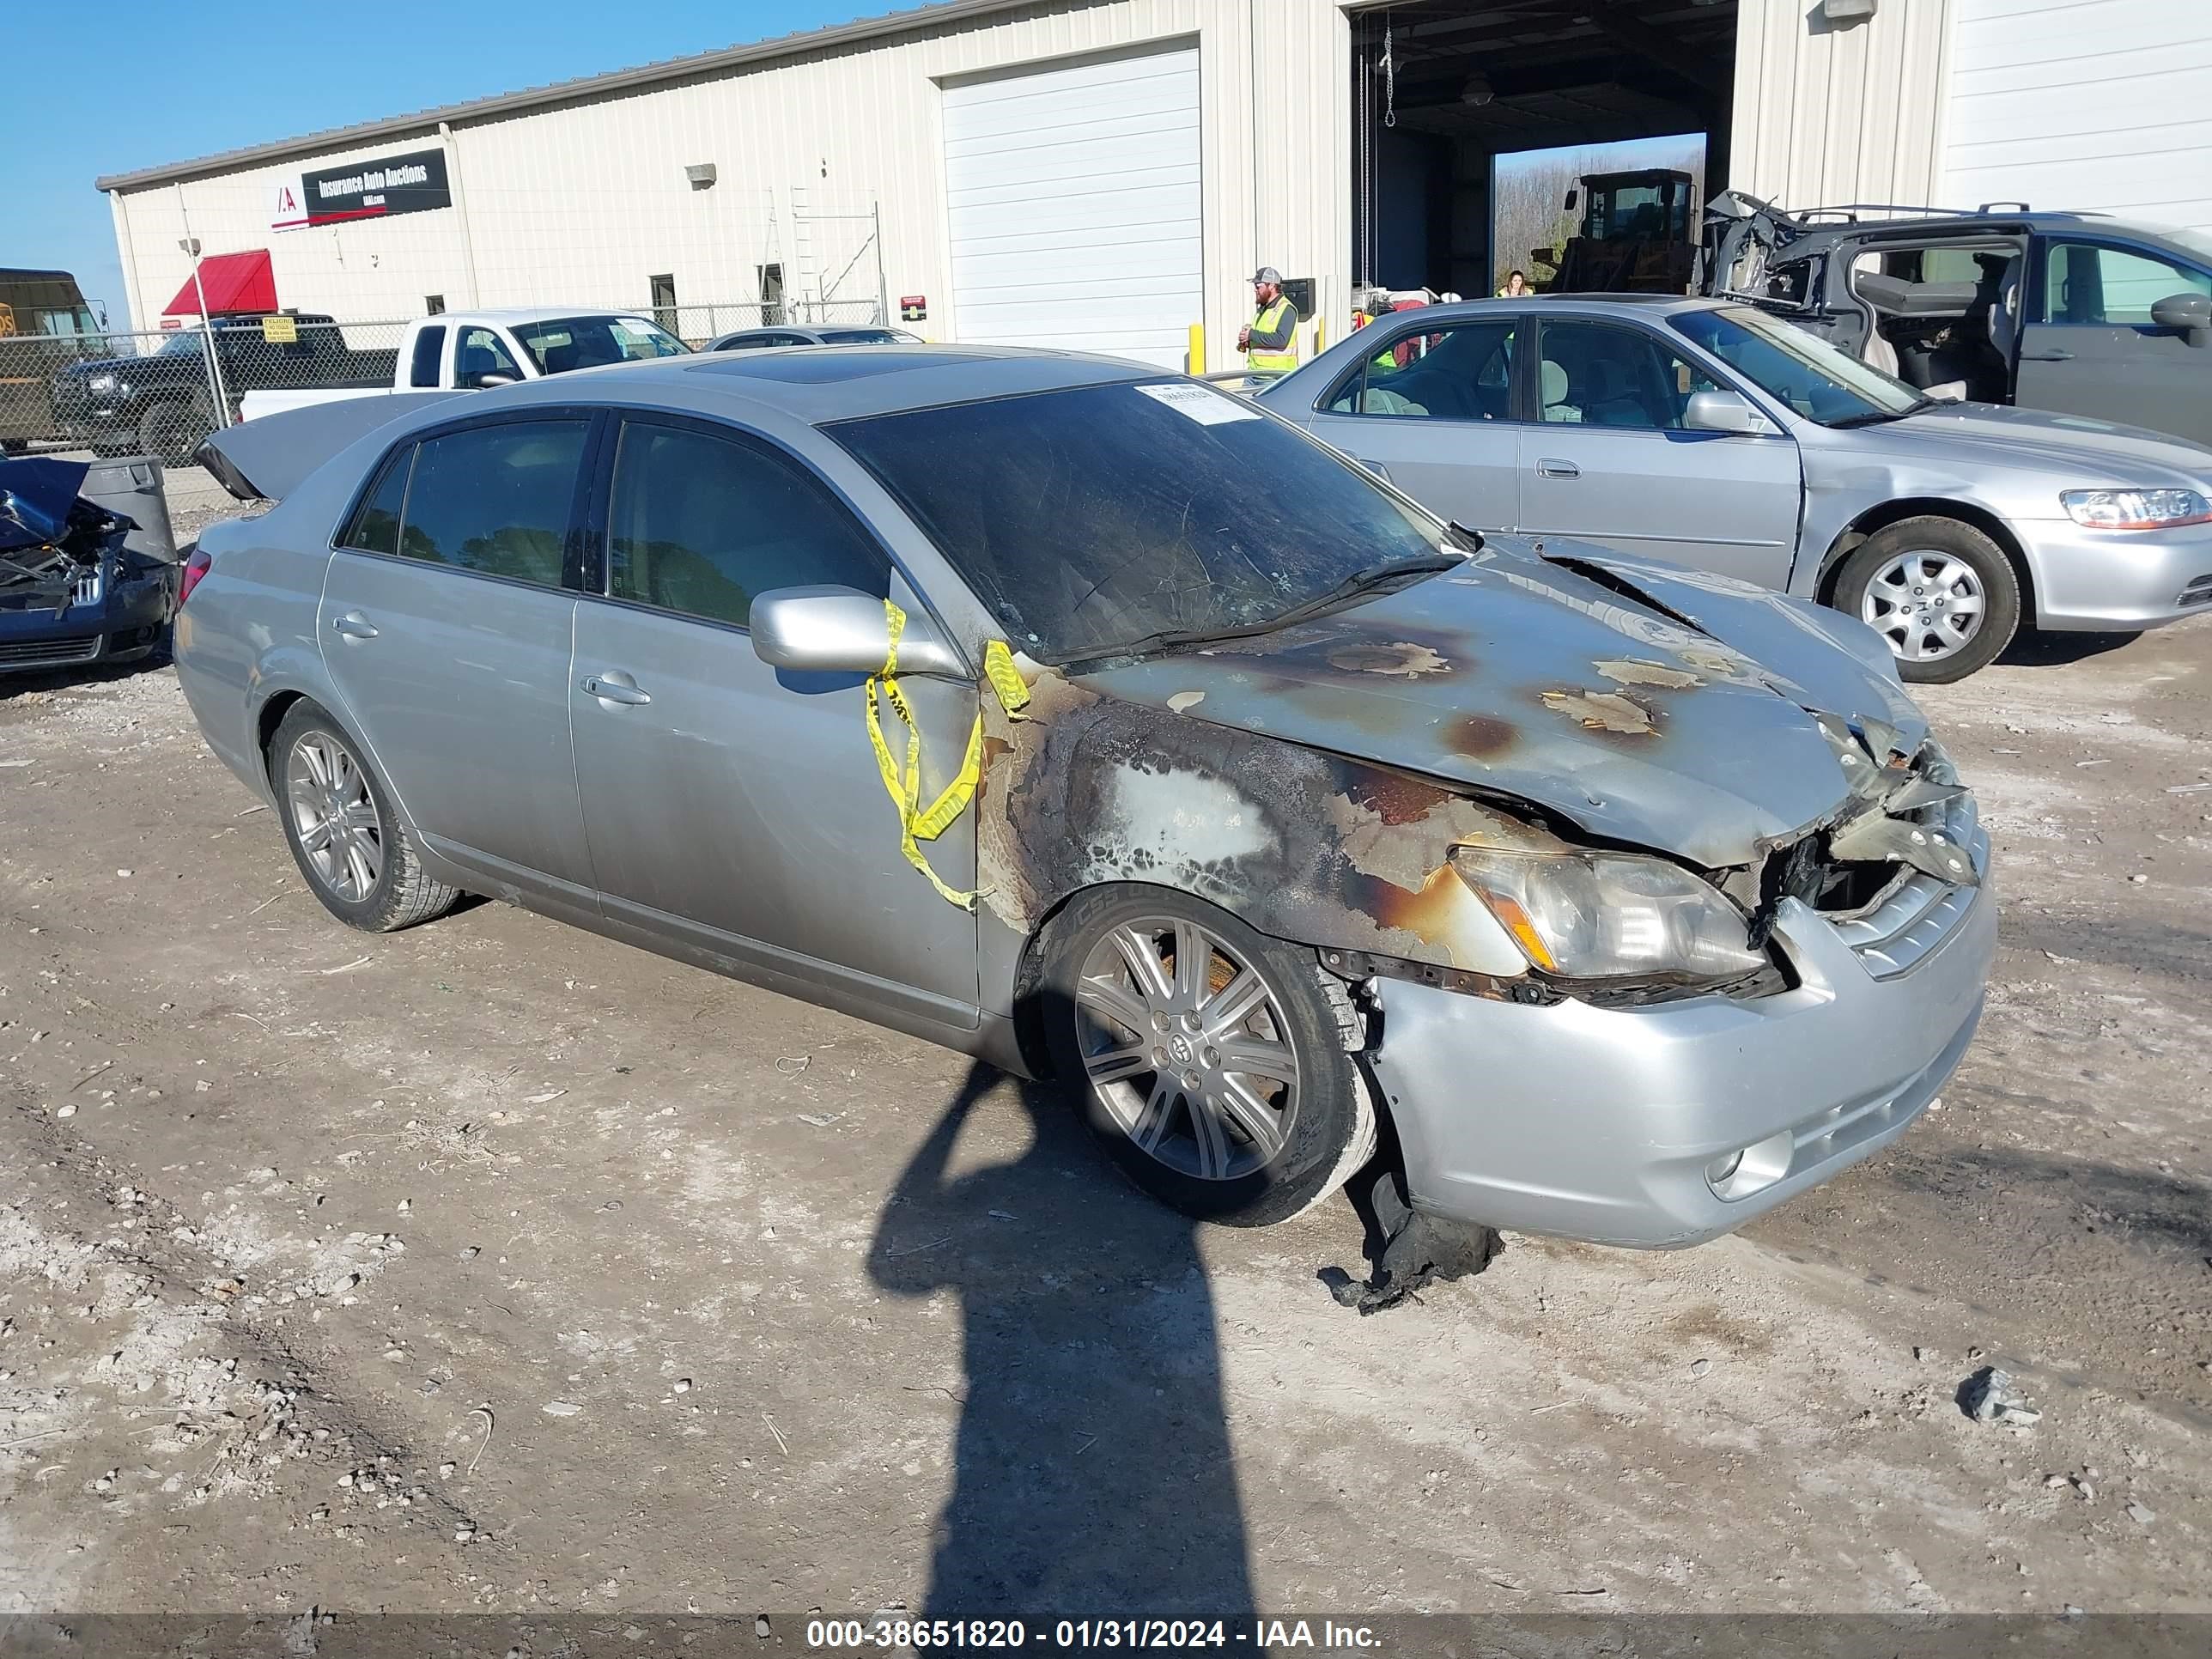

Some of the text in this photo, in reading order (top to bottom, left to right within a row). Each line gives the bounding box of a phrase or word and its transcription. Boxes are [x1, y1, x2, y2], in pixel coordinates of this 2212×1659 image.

[319, 164, 427, 198] Insurance Auto Auctions
